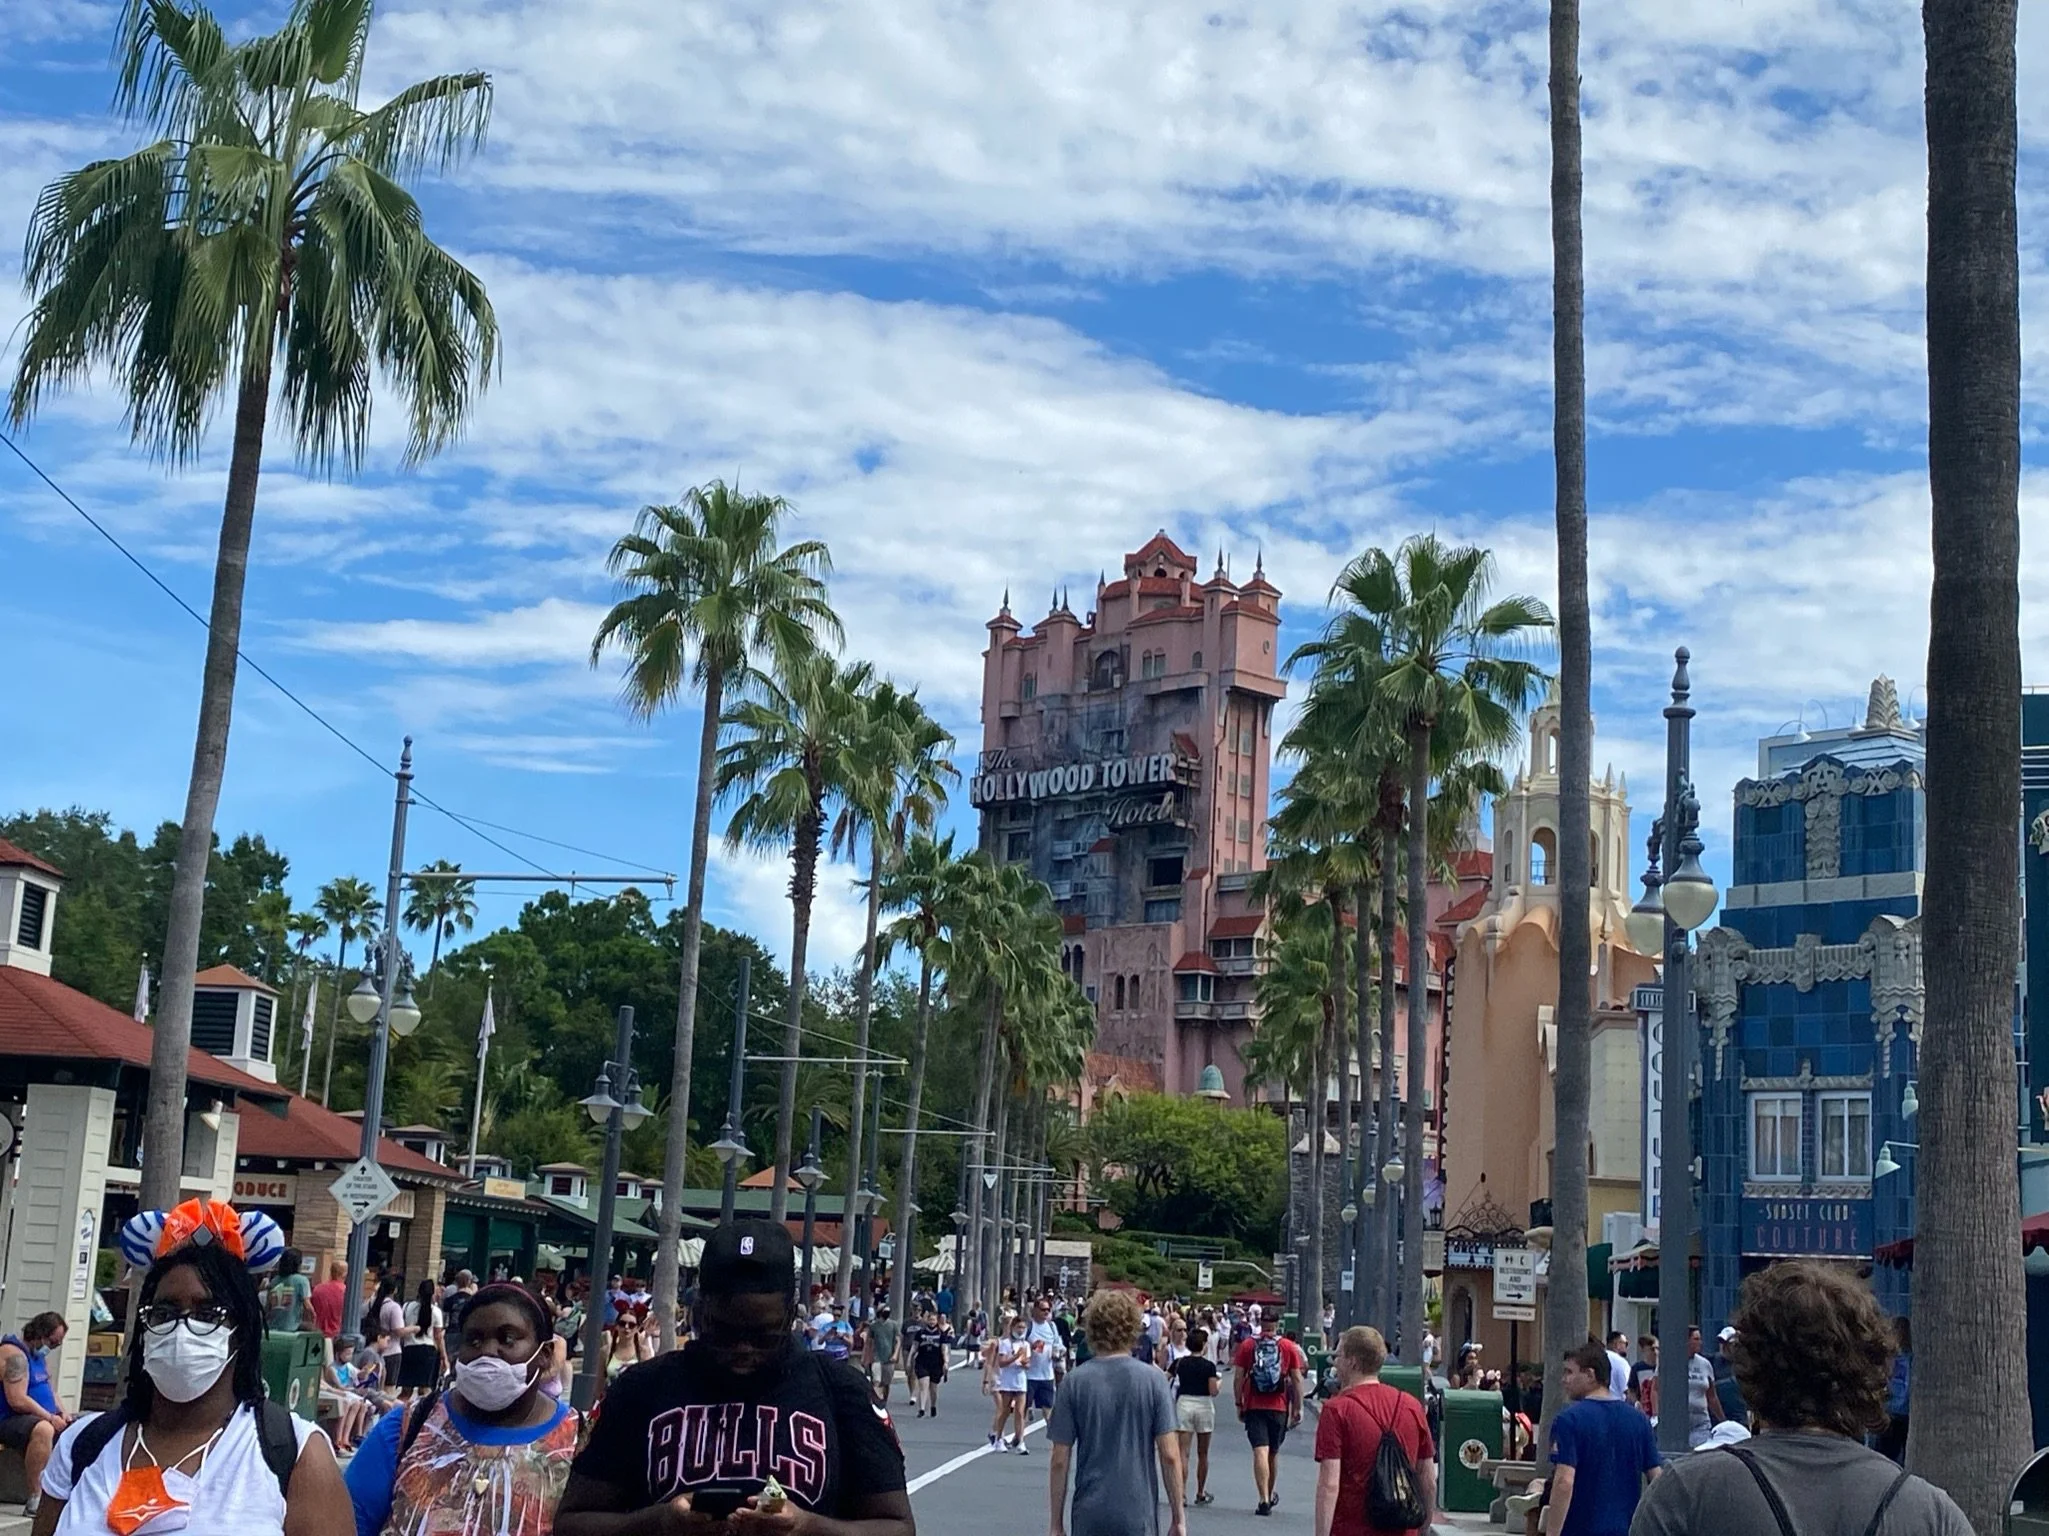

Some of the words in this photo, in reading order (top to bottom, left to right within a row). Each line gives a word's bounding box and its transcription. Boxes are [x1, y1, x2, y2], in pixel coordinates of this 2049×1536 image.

[984, 749, 1014, 771] The
[971, 763, 1095, 803] HOLLYWOOD
[1101, 752, 1177, 788] TOWER
[1105, 791, 1175, 826] Hotel
[1640, 992, 1664, 1007] SUNSE
[233, 1181, 288, 1198] ODUCE
[1765, 1203, 1810, 1220] SUNSET
[1819, 1204, 1849, 1221] CLUB
[1757, 1226, 1857, 1250] COUTURE
[648, 1402, 826, 1506] BULLS
